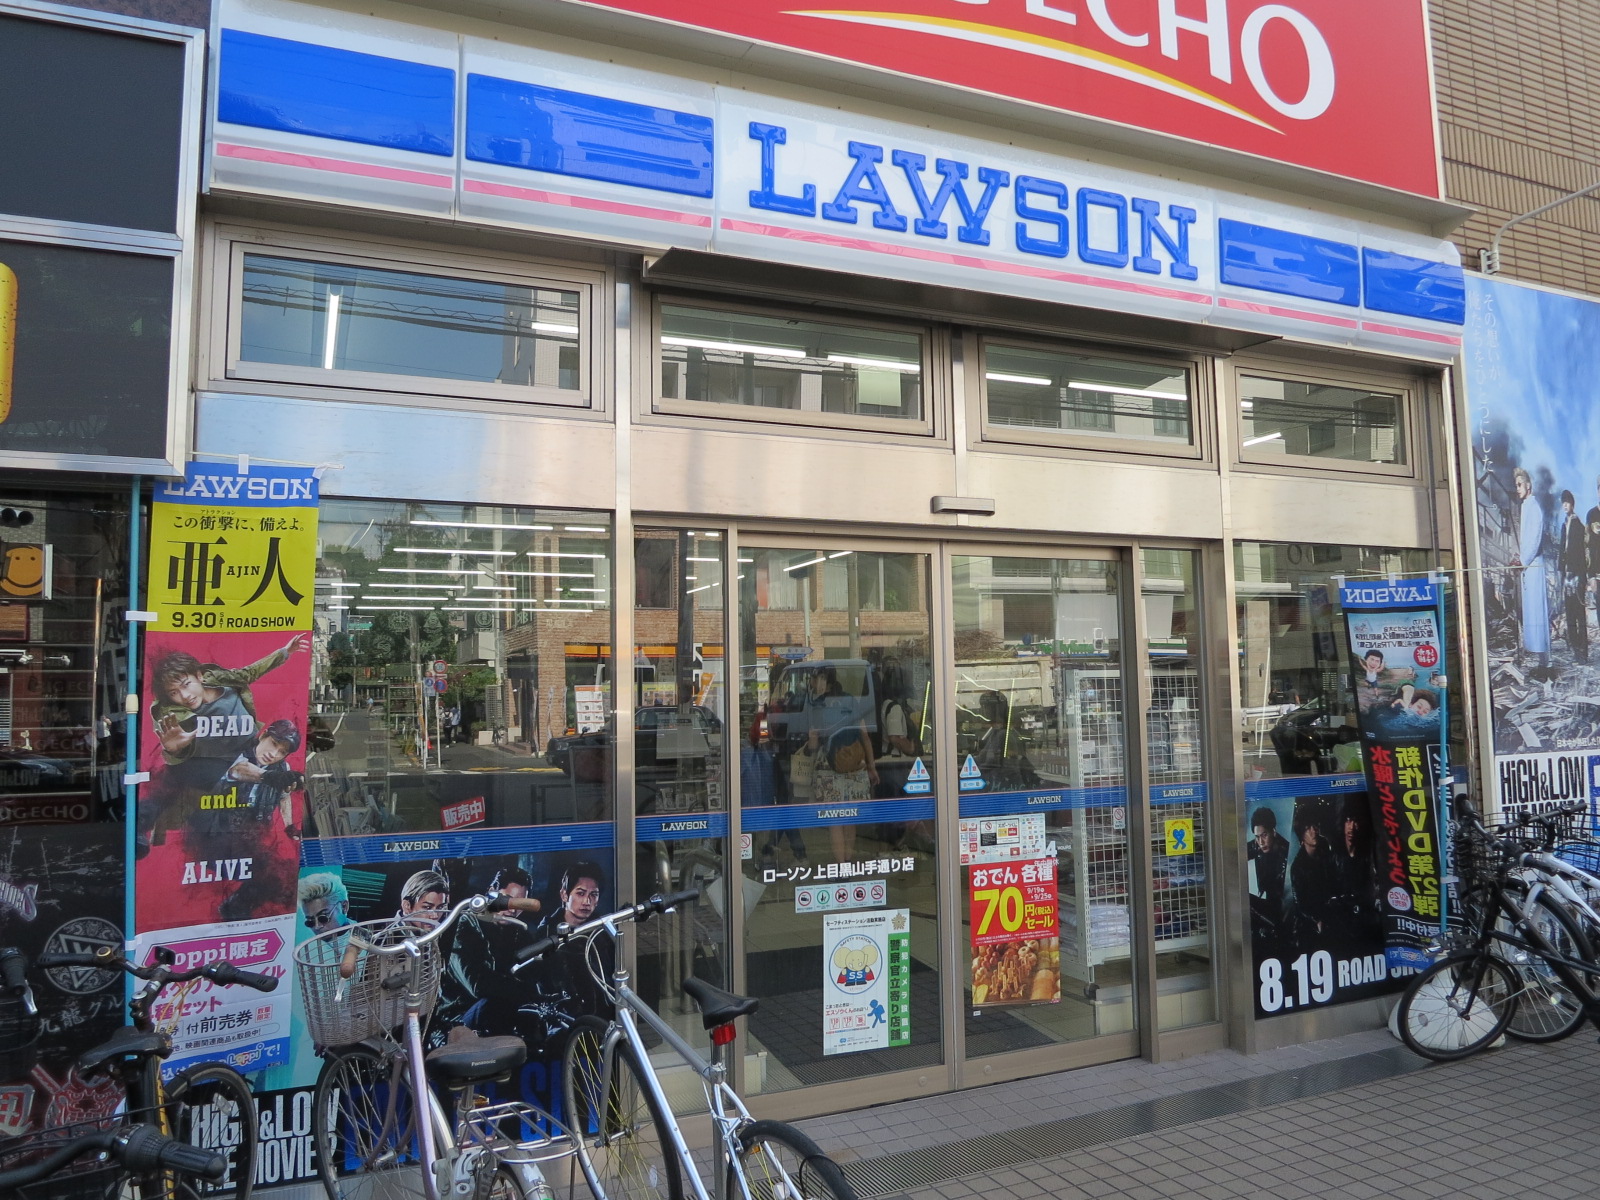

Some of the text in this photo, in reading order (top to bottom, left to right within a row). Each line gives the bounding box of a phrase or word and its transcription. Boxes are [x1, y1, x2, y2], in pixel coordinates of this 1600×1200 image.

[748, 121, 1198, 281] LAWSON
[163, 474, 314, 500] LAWSON
[173, 515, 305, 532] この衝撃に、備えよ。
[226, 566, 261, 578] AJIN
[172, 611, 217, 629] 9.30
[195, 715, 255, 738] DEAD
[1330, 778, 1358, 788] LAWSON
[1027, 796, 1062, 805] LAWSON
[1163, 788, 1194, 798] LAWSON
[443, 800, 485, 828] 販売中
[817, 808, 858, 819] LAWSON
[661, 820, 708, 832] LAWSON
[384, 840, 440, 853] LAWSON
[181, 857, 254, 885] ALIVE
[762, 857, 915, 883] ローソン 上目黒山手通り店
[973, 864, 1054, 887] おでん 各種
[973, 886, 1025, 935] 70
[1024, 915, 1055, 930] セール
[172, 938, 270, 972] oppi限定
[848, 971, 863, 980] SS
[1259, 950, 1387, 1012] 8.19 ROAD
[186, 1009, 253, 1036] 付前売券
[256, 1014, 272, 1022] 限定
